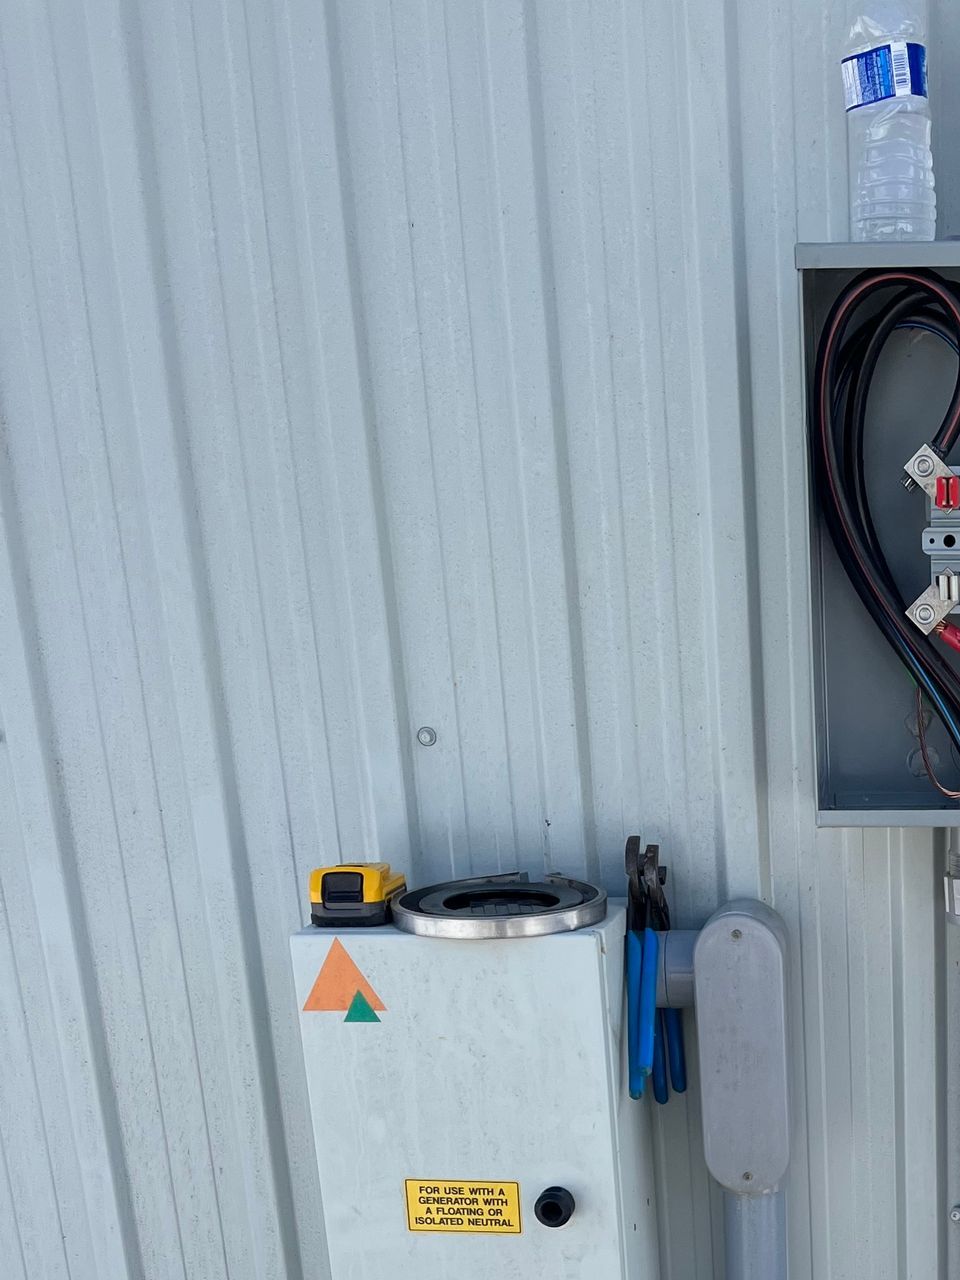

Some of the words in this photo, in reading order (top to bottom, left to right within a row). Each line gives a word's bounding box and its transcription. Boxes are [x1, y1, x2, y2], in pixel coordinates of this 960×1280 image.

[419, 1186, 440, 1195] FOR
[444, 1187, 465, 1195] USE
[469, 1187, 494, 1196] WITH
[498, 1188, 505, 1196] A
[418, 1196, 479, 1206] GENERATOR
[483, 1198, 508, 1206] WITH
[425, 1207, 432, 1215] A
[436, 1207, 484, 1216] FLOATING
[488, 1208, 503, 1217] OR
[415, 1217, 464, 1225] ISOLATED
[468, 1218, 514, 1227] NEUTRAL
